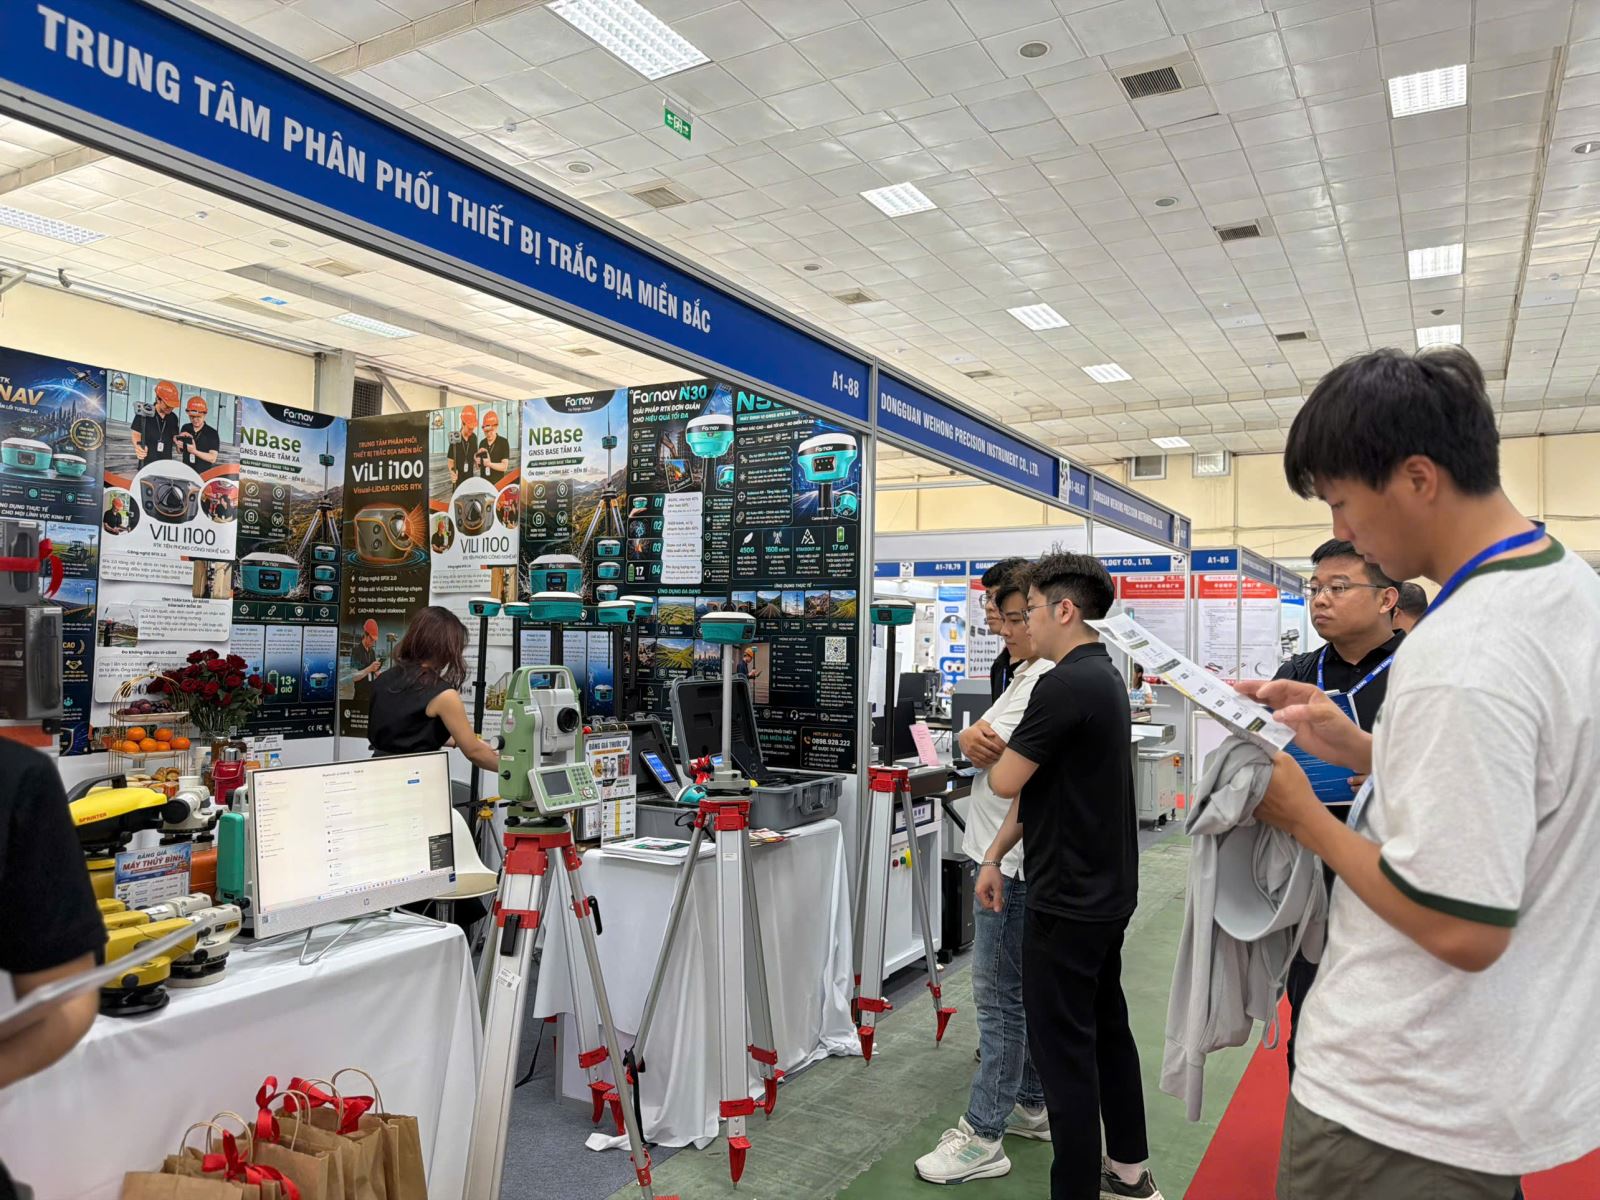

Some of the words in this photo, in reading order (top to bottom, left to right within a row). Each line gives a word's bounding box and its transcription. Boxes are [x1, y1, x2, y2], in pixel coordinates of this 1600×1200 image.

[37, 4, 181, 105] TRUNG
[194, 75, 271, 143] TÂM
[283, 116, 367, 183] PHÂN
[376, 159, 440, 216] PHỐI
[448, 191, 514, 247] THIẾT
[520, 224, 541, 265] BỊ
[548, 237, 598, 283] TRẮC
[603, 264, 633, 302] ĐỊA
[638, 279, 678, 319] MIỀN
[682, 298, 712, 334] BẮC
[832, 370, 860, 399] A1-88
[632, 388, 678, 404] Farnav
[680, 384, 708, 400] N30
[565, 396, 594, 407] Farnav
[284, 408, 314, 422] Farnav
[529, 427, 583, 446] NBase
[880, 392, 922, 427] DONGGUAN
[923, 414, 954, 440] WEIHONG
[954, 427, 986, 455] PRECISION
[986, 440, 1019, 473] INSTRUMENT
[240, 426, 302, 453] NBase
[240, 447, 258, 456] GNSS
[259, 450, 276, 459] BASE
[352, 460, 383, 482] ViLi
[388, 460, 424, 479] i100
[654, 498, 663, 507] 01
[652, 543, 661, 552] 03
[1123, 558, 1137, 566] CO.,
[1138, 558, 1152, 566] LTD.
[1208, 556, 1229, 564] A1-85
[635, 566, 644, 575] 17
[652, 564, 661, 574] 04
[281, 676, 296, 685] 13+
[281, 686, 293, 694] GIỜ
[79, 812, 107, 823] SPRINTER
[122, 860, 140, 871] MÁY
